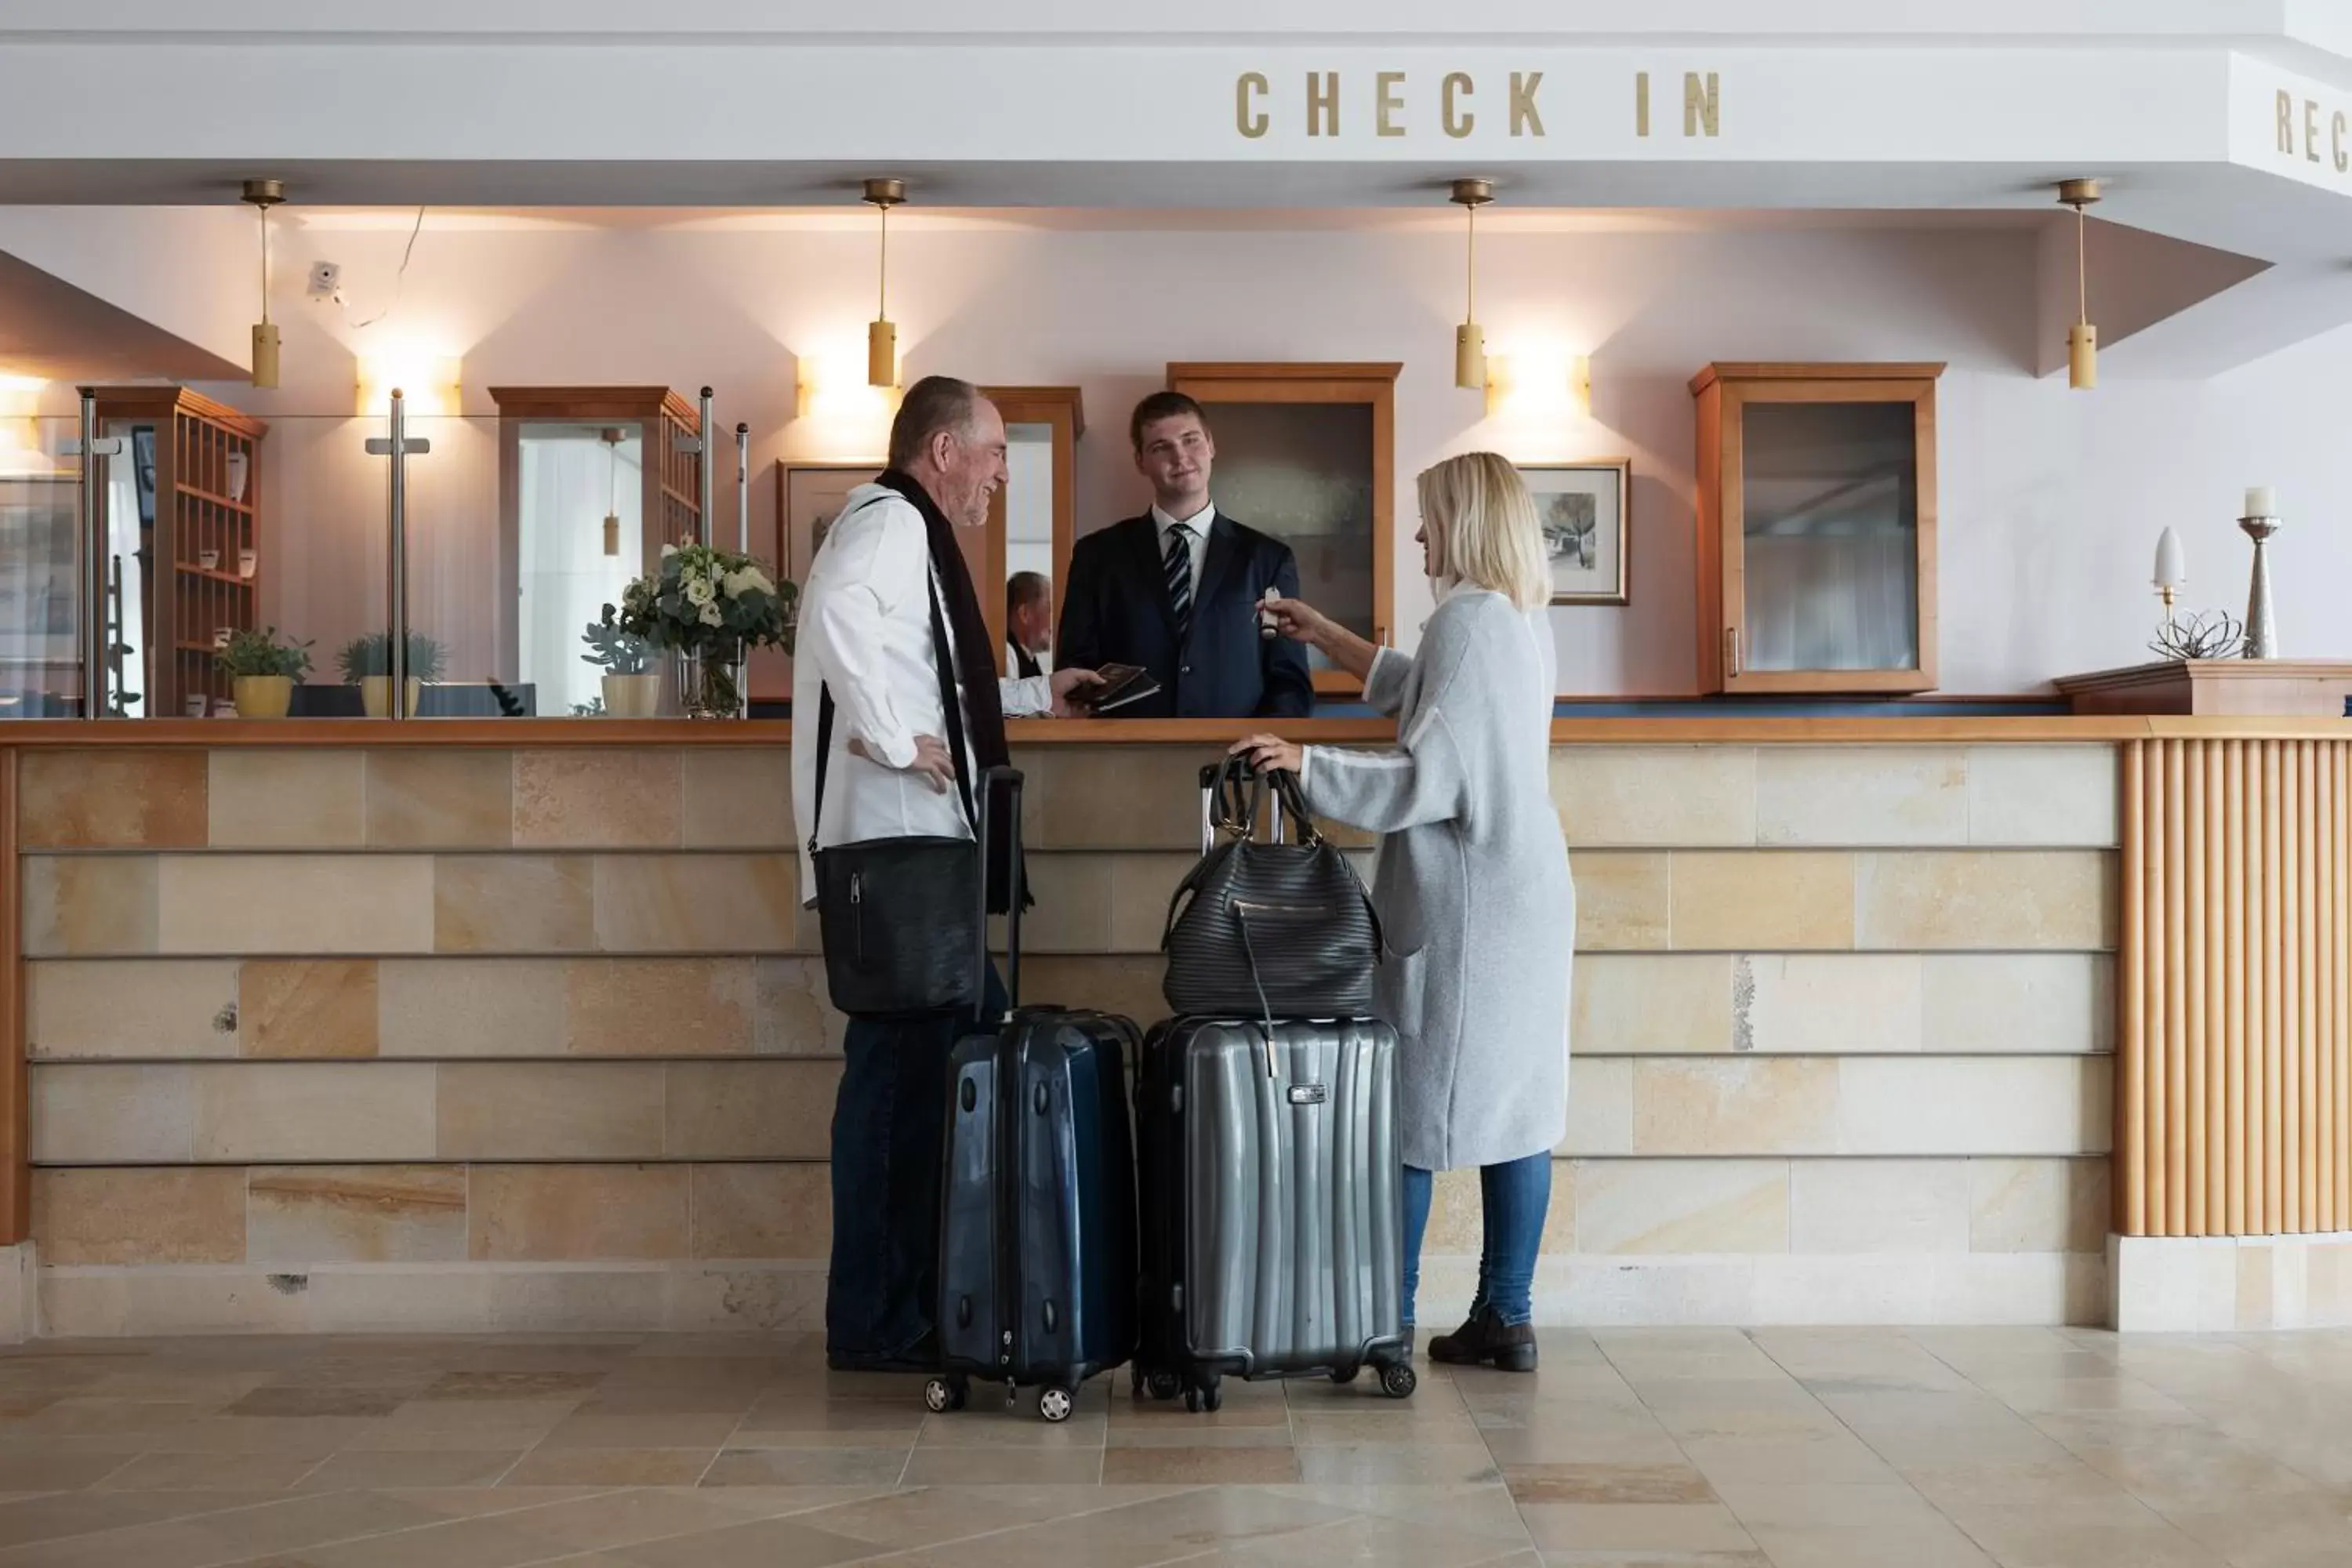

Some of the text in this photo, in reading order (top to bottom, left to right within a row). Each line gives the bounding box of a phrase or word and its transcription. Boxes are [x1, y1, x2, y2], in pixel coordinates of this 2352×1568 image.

[1236, 71, 1719, 139] CHECK IN
[2276, 88, 2348, 173] REC
